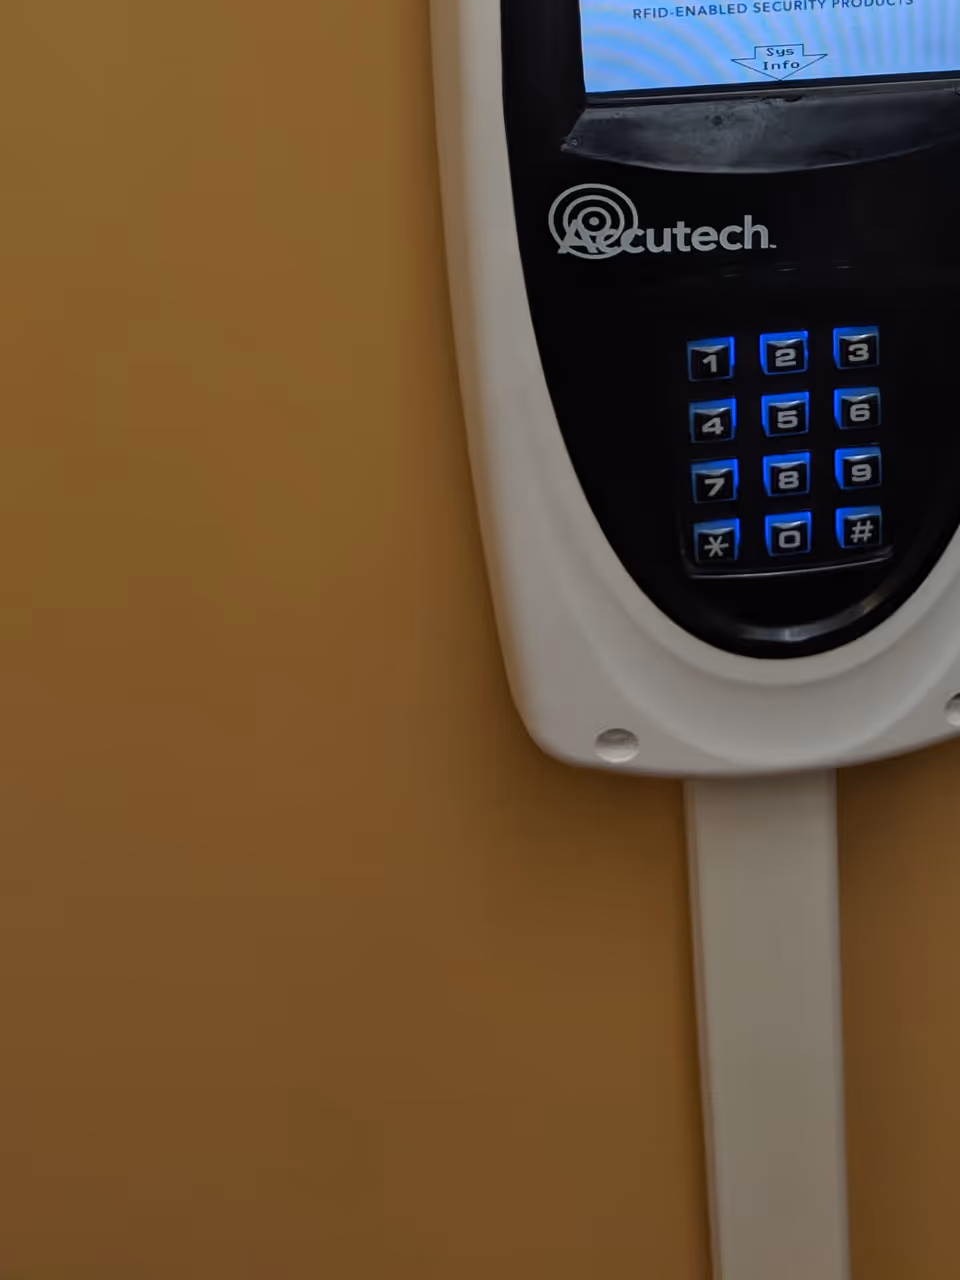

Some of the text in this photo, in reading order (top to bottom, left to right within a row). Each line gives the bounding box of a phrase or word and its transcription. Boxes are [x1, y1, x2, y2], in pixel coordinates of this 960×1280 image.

[632, 3, 748, 20] RFID-ENABLED
[765, 46, 795, 58] Sys
[762, 59, 800, 71] Info
[775, 348, 797, 368] 2
[848, 343, 870, 362] 3
[702, 354, 718, 373] 1
[777, 410, 798, 429] 5
[850, 403, 871, 422] 6
[701, 417, 724, 435] 4
[778, 471, 799, 489] 8
[851, 463, 872, 482] 9
[704, 477, 725, 497] 7
